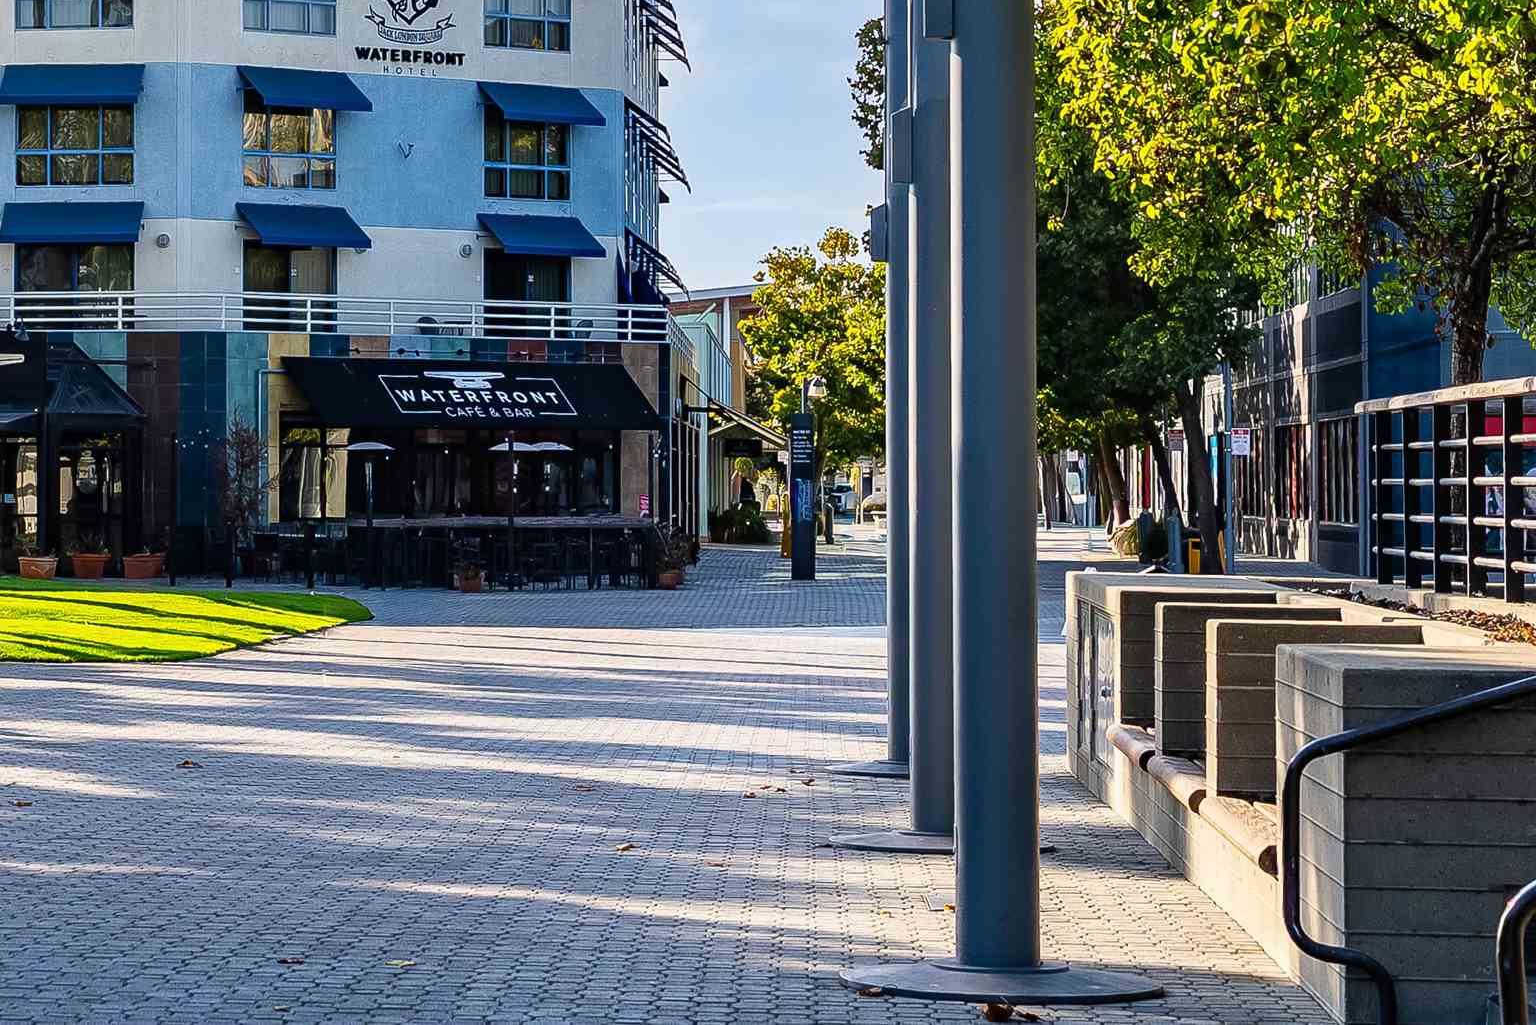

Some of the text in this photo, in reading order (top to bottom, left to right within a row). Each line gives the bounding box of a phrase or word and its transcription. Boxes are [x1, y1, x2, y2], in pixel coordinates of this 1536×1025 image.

[355, 46, 466, 66] WATERFRONT
[383, 65, 438, 77] HOTEL
[395, 389, 560, 404] WATERFRONT
[445, 406, 536, 419] CAFÉ & BAR
